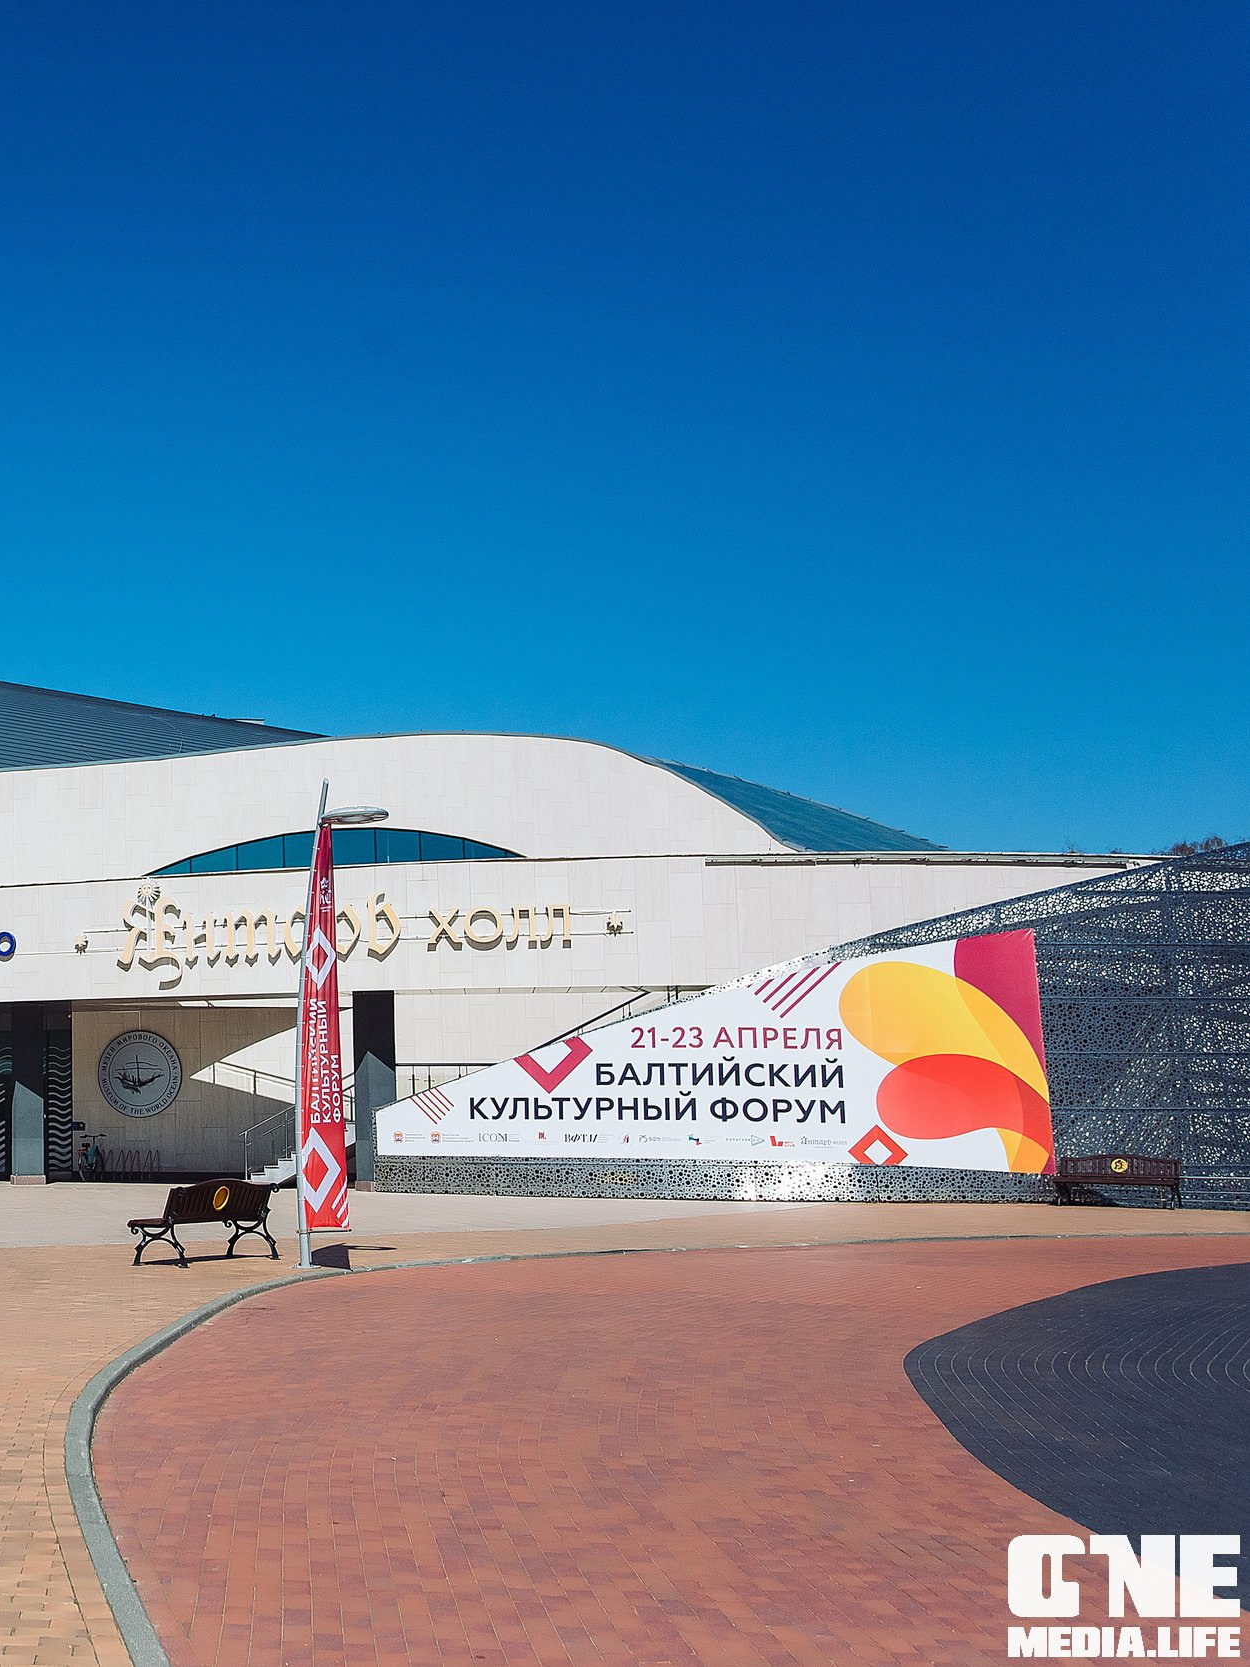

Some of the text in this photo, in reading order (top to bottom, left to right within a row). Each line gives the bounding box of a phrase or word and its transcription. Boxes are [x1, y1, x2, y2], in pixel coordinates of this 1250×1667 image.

[116, 1033, 158, 1046] МИРОВОГО
[158, 1041, 179, 1071] ОКЕАНА
[631, 1026, 843, 1050] 21-23 АПРЕЛЯ
[317, 1000, 332, 1124] КУЛЬТУРНЫЙ
[596, 1056, 844, 1089] БАЛТИЙСКИЙ
[101, 1077, 179, 1115] MUSEUM OF THE WORLD OCEAN
[331, 1054, 342, 1123] ФОРУМ
[469, 1090, 846, 1124] КУЛЬТУРНЫЙ ФОРУМ
